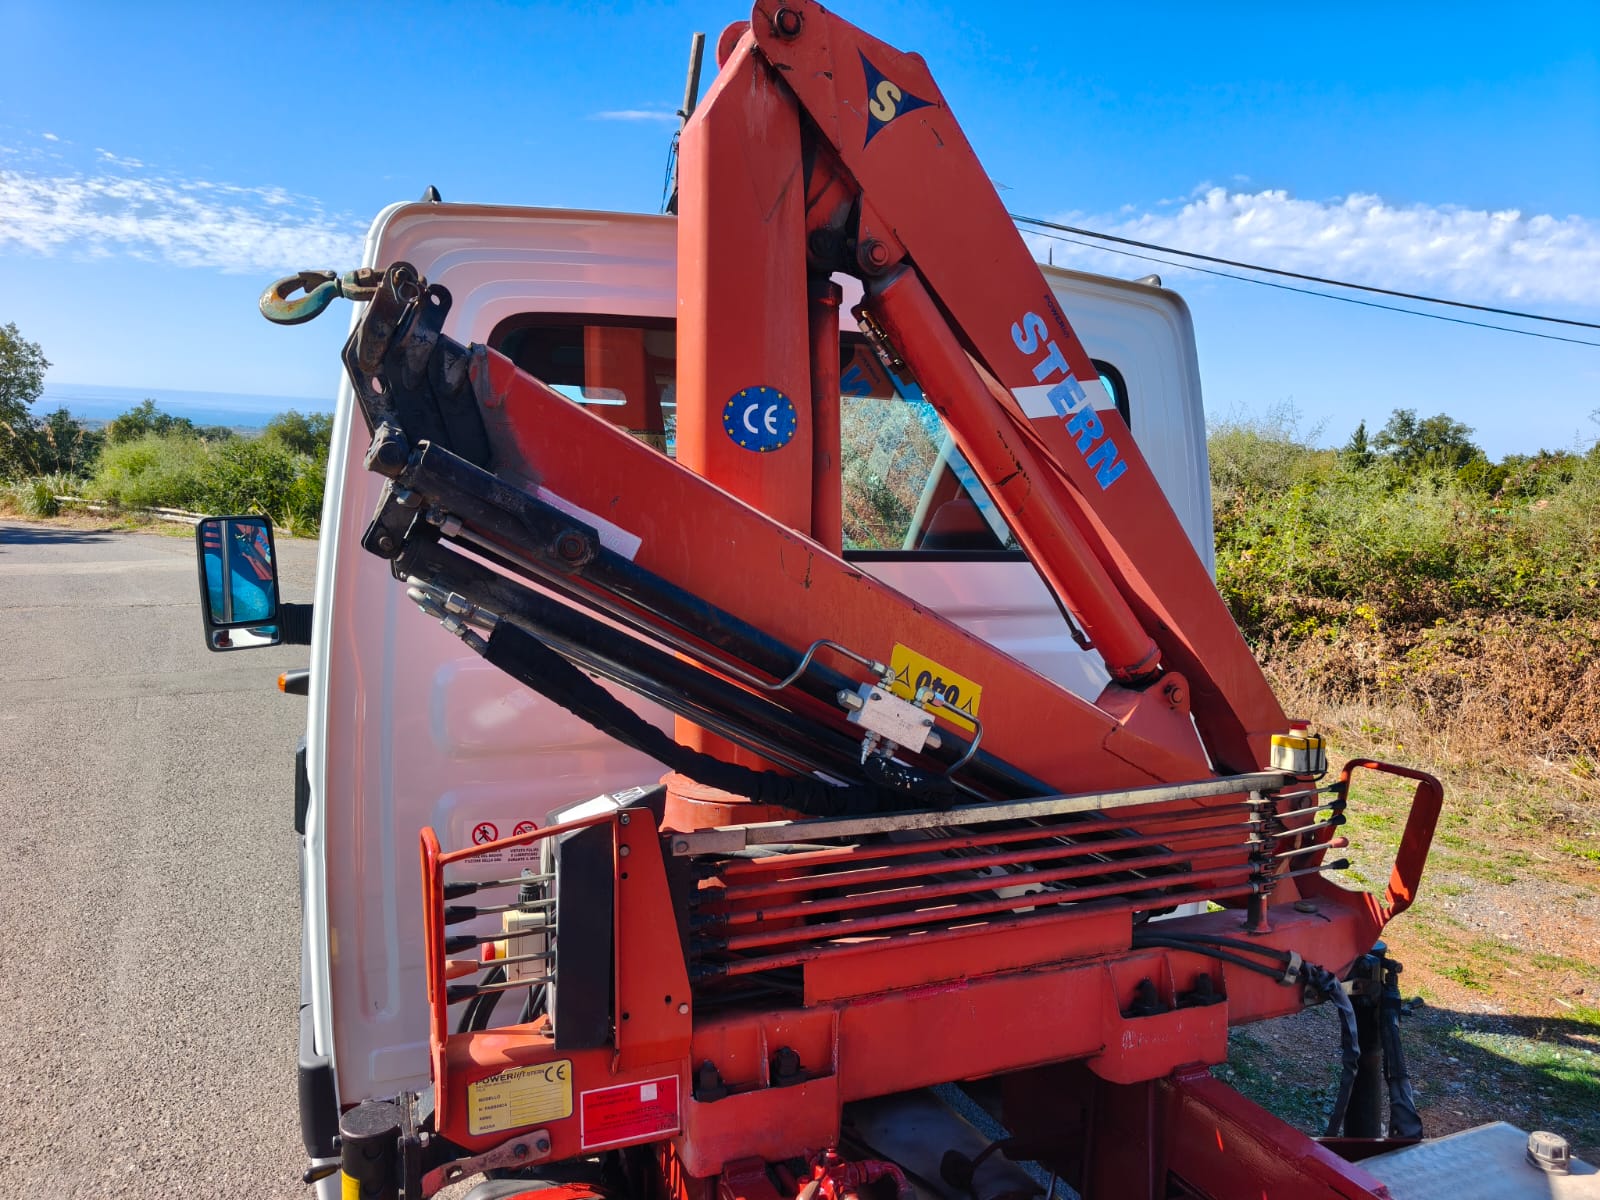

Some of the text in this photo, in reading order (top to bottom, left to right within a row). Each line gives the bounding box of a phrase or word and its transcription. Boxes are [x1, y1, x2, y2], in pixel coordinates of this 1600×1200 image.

[869, 80, 902, 122] S
[743, 403, 778, 435] CE
[1011, 311, 1128, 490] STERN
[545, 1064, 566, 1083] CE
